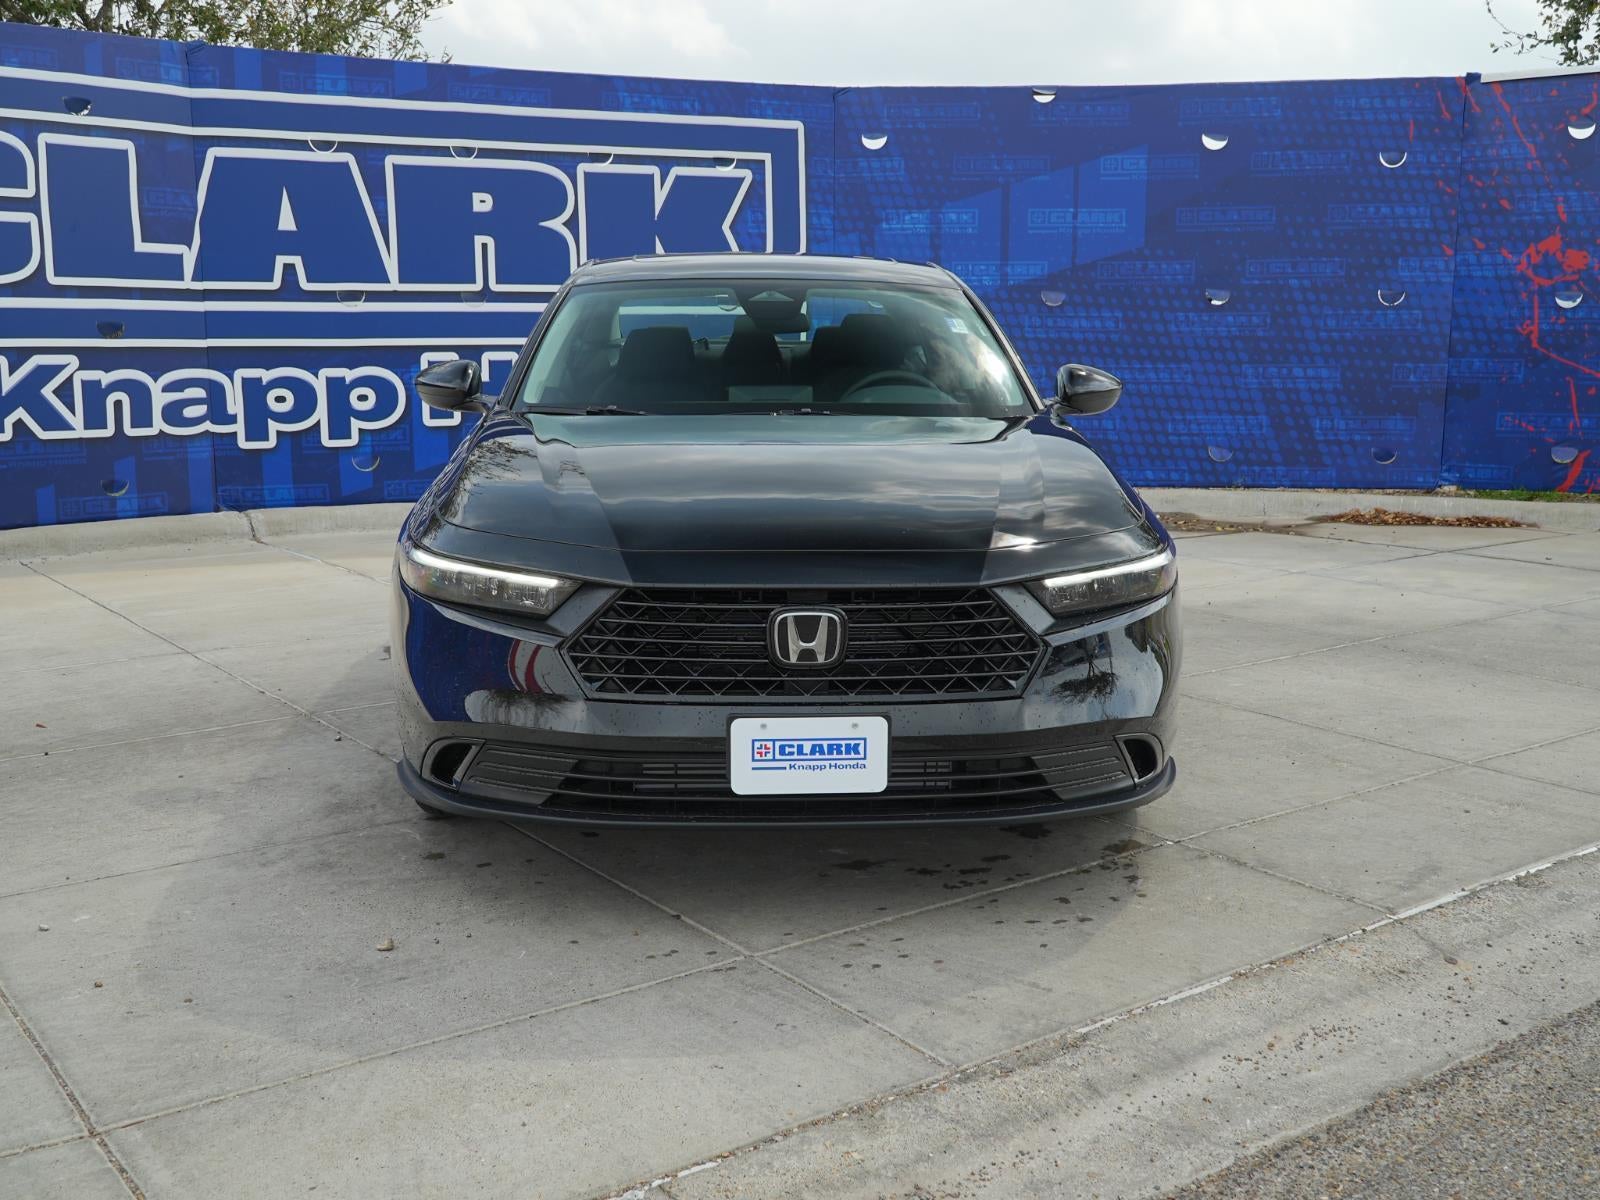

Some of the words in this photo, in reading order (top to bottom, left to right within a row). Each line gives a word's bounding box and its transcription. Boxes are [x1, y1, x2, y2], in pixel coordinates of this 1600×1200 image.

[0, 130, 755, 292] LARK
[778, 742, 861, 757] CLARK
[788, 763, 826, 772] Knapp
[829, 762, 866, 770] Honda
